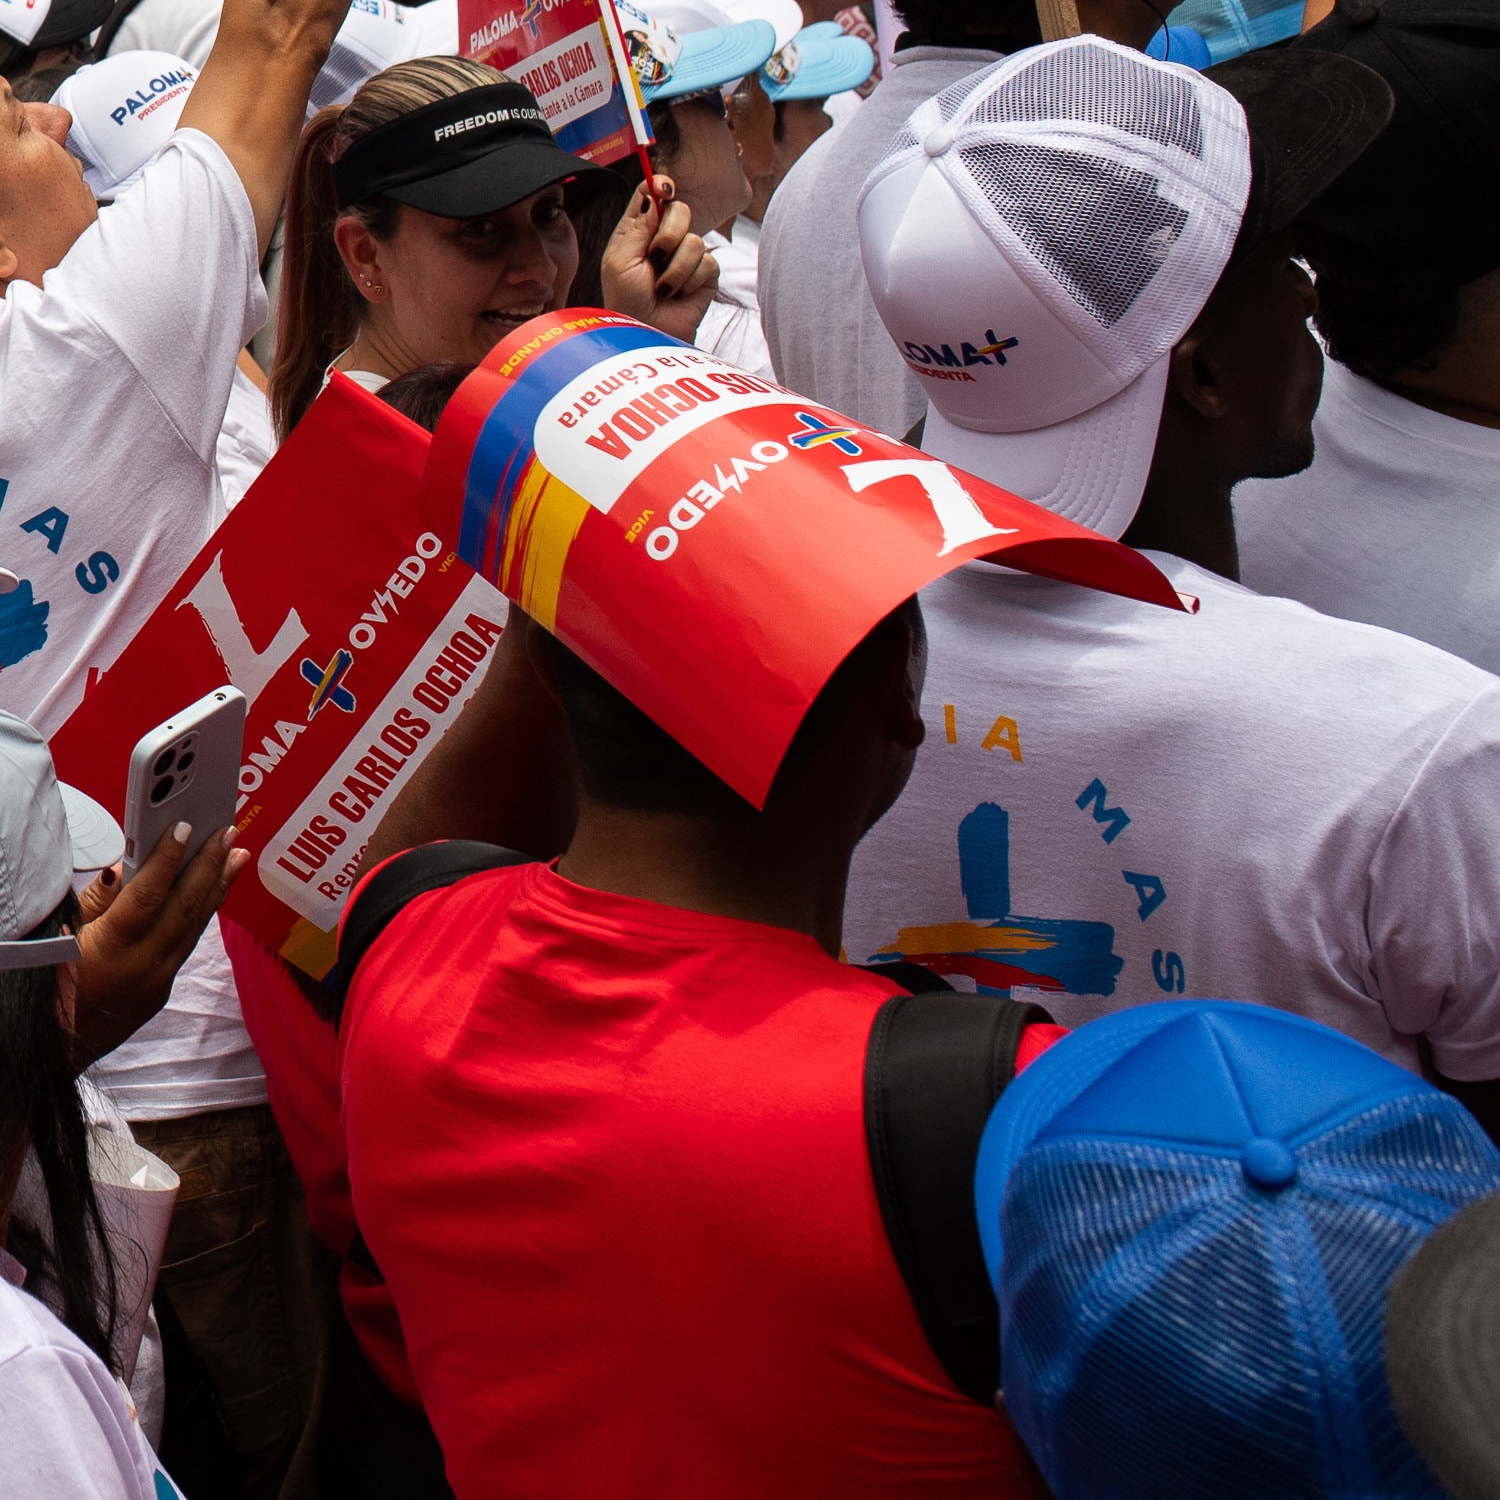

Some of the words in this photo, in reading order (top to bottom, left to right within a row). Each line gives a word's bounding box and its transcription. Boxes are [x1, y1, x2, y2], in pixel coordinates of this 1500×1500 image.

[470, 10, 519, 54] PALOMA
[110, 67, 189, 126] PALOMA
[520, 60, 556, 98] CARLOS
[556, 42, 597, 81] OCHOA
[560, 97, 568, 110] a
[568, 93, 574, 108] la
[574, 78, 604, 102] Cámara
[138, 86, 189, 121] PRESIDENTA
[434, 108, 510, 143] FREEDOM
[511, 106, 524, 122] IS
[500, 325, 570, 378] GRANDE
[556, 363, 657, 431] Cámara
[584, 378, 705, 462] OCHOA
[624, 508, 654, 544] VICE
[645, 439, 789, 562] OVIEDO
[348, 531, 444, 650] OVIEDO
[276, 814, 348, 884] LUIS
[328, 707, 431, 824] CARLOS
[412, 612, 504, 715] OCHOA
